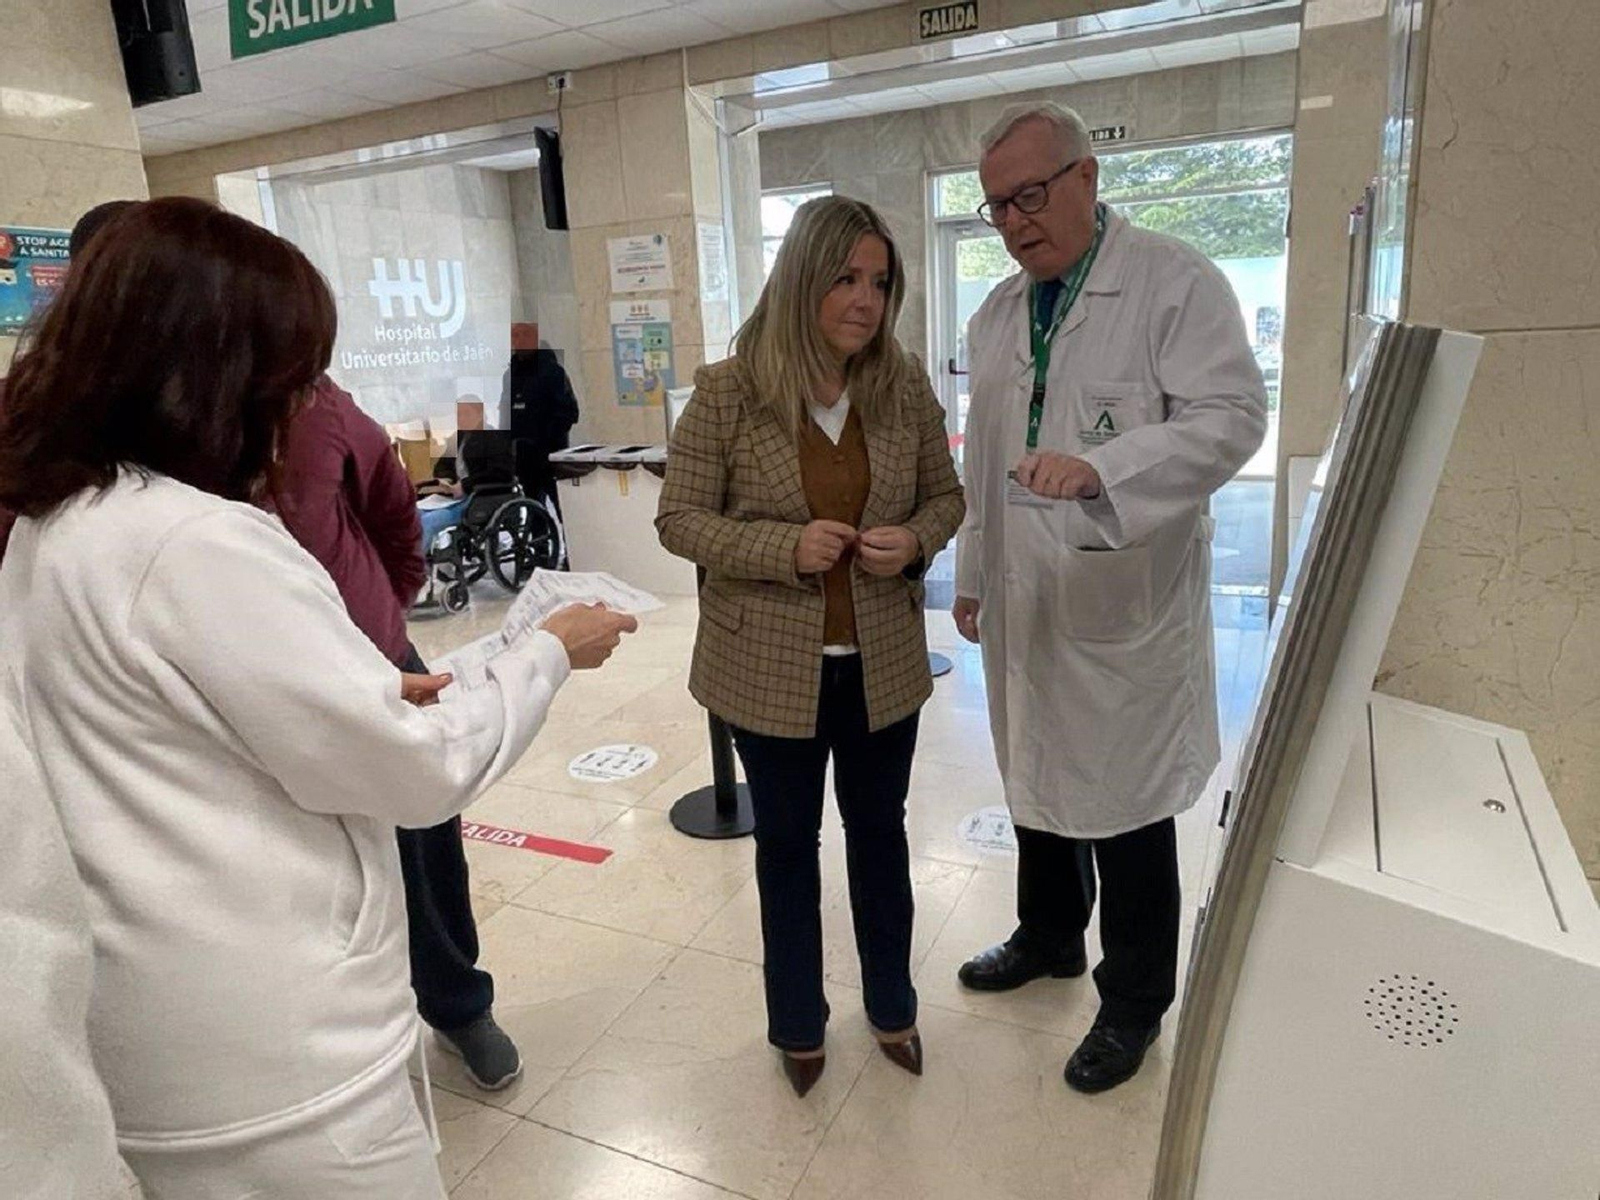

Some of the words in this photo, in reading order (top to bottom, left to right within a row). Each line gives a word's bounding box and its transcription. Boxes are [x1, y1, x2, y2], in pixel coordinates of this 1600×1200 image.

[247, 0, 374, 38] SALID
[921, 4, 978, 37] SALIDA
[16, 236, 46, 246] STOP
[374, 323, 437, 345] Hospital
[341, 347, 439, 369] Universitario
[443, 346, 459, 362] de
[461, 823, 527, 847] ALIDA
